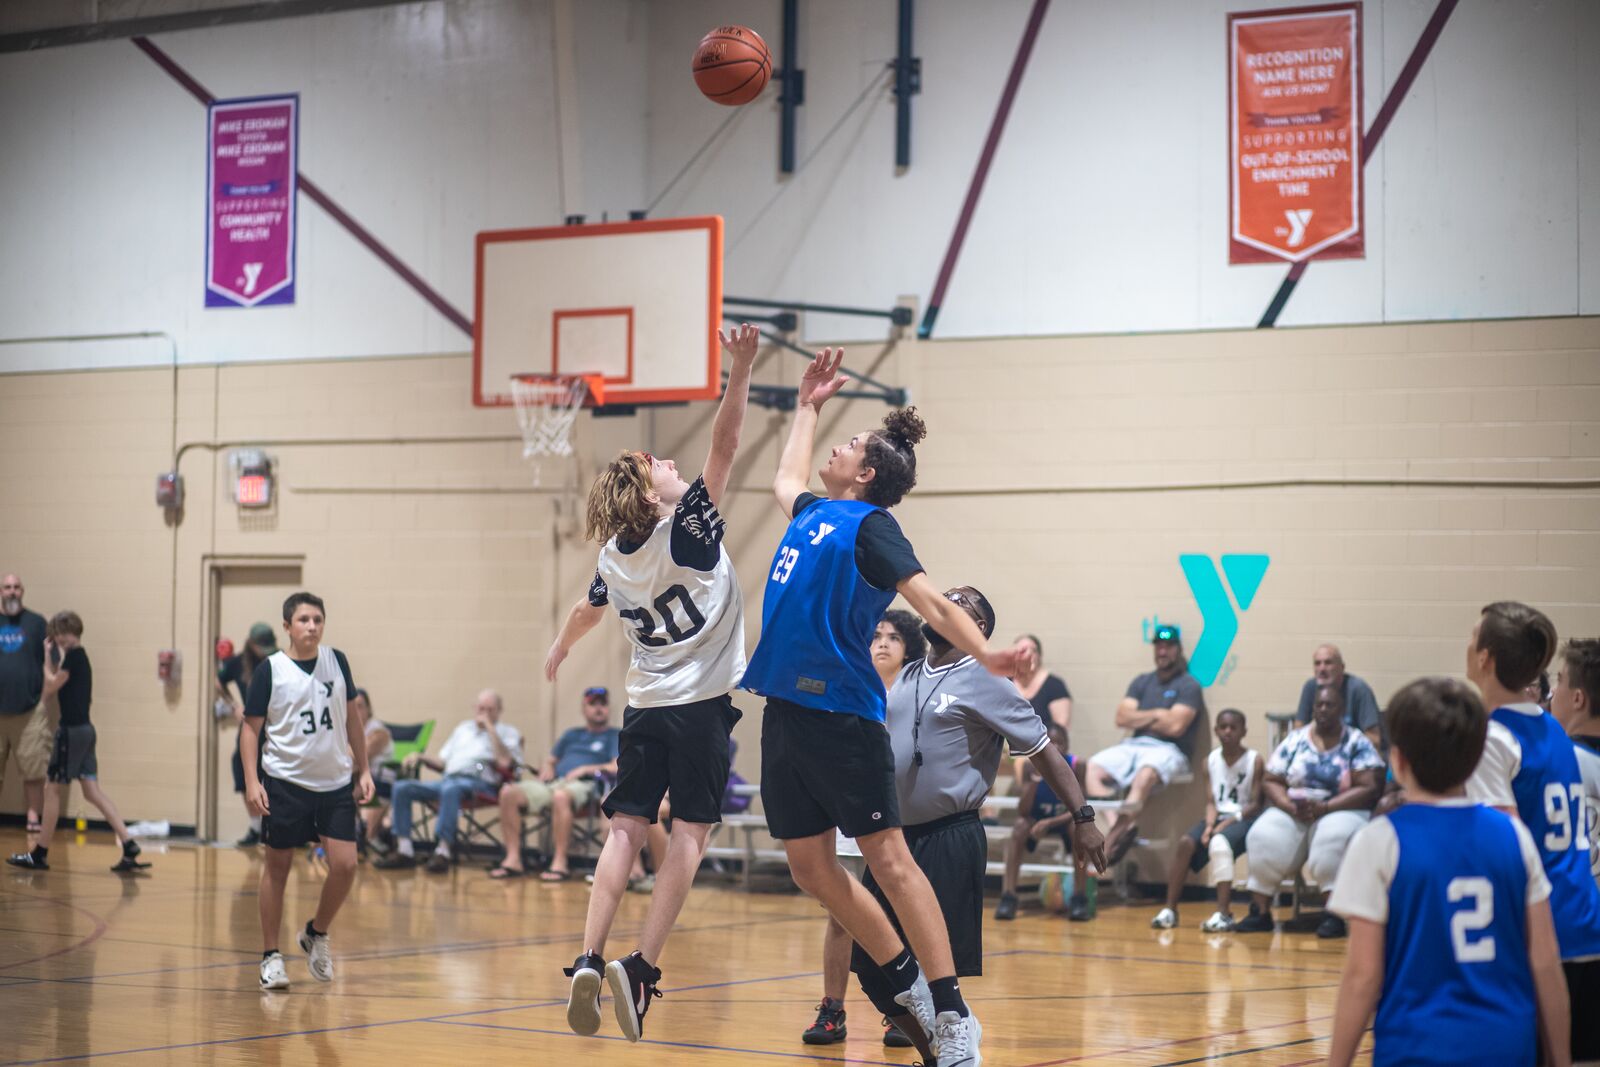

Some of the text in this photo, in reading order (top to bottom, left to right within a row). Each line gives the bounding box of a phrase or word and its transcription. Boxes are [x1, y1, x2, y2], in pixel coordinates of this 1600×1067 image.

[1246, 47, 1344, 68] RECOGNITION
[1253, 64, 1336, 85] NAME HERE
[1243, 128, 1347, 149] SUPPORTING
[1241, 148, 1350, 169] OUT-OF-SCHOOL
[1252, 163, 1337, 183] ENRICHMENT
[1276, 181, 1310, 197] TIME
[219, 211, 283, 229] COMMUNITY
[771, 545, 800, 585] 29
[300, 706, 334, 735] 34
[1218, 783, 1240, 804] 14
[1544, 782, 1591, 852] 97
[1447, 876, 1496, 963] 2
